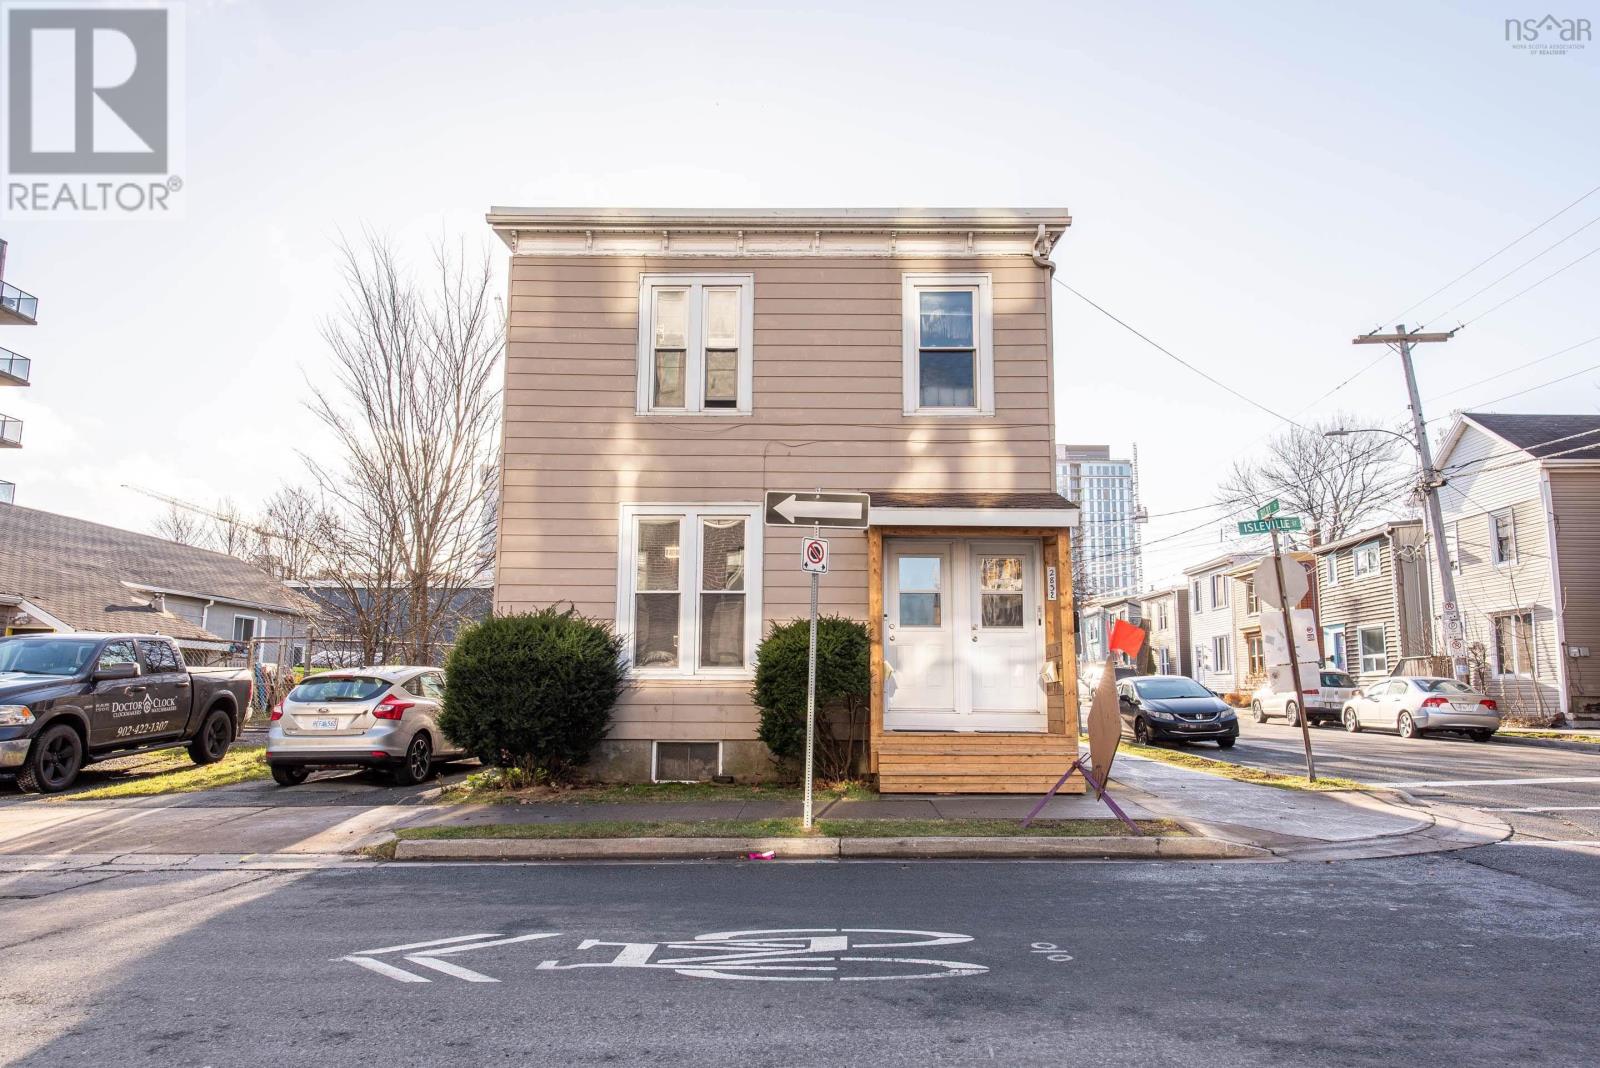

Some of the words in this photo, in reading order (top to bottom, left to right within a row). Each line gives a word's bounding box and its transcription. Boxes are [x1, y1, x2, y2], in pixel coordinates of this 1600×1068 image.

[1244, 519, 1290, 532] ISLEVILLE
[112, 702, 142, 712] DOCTOR
[153, 698, 175, 708] CLOCK
